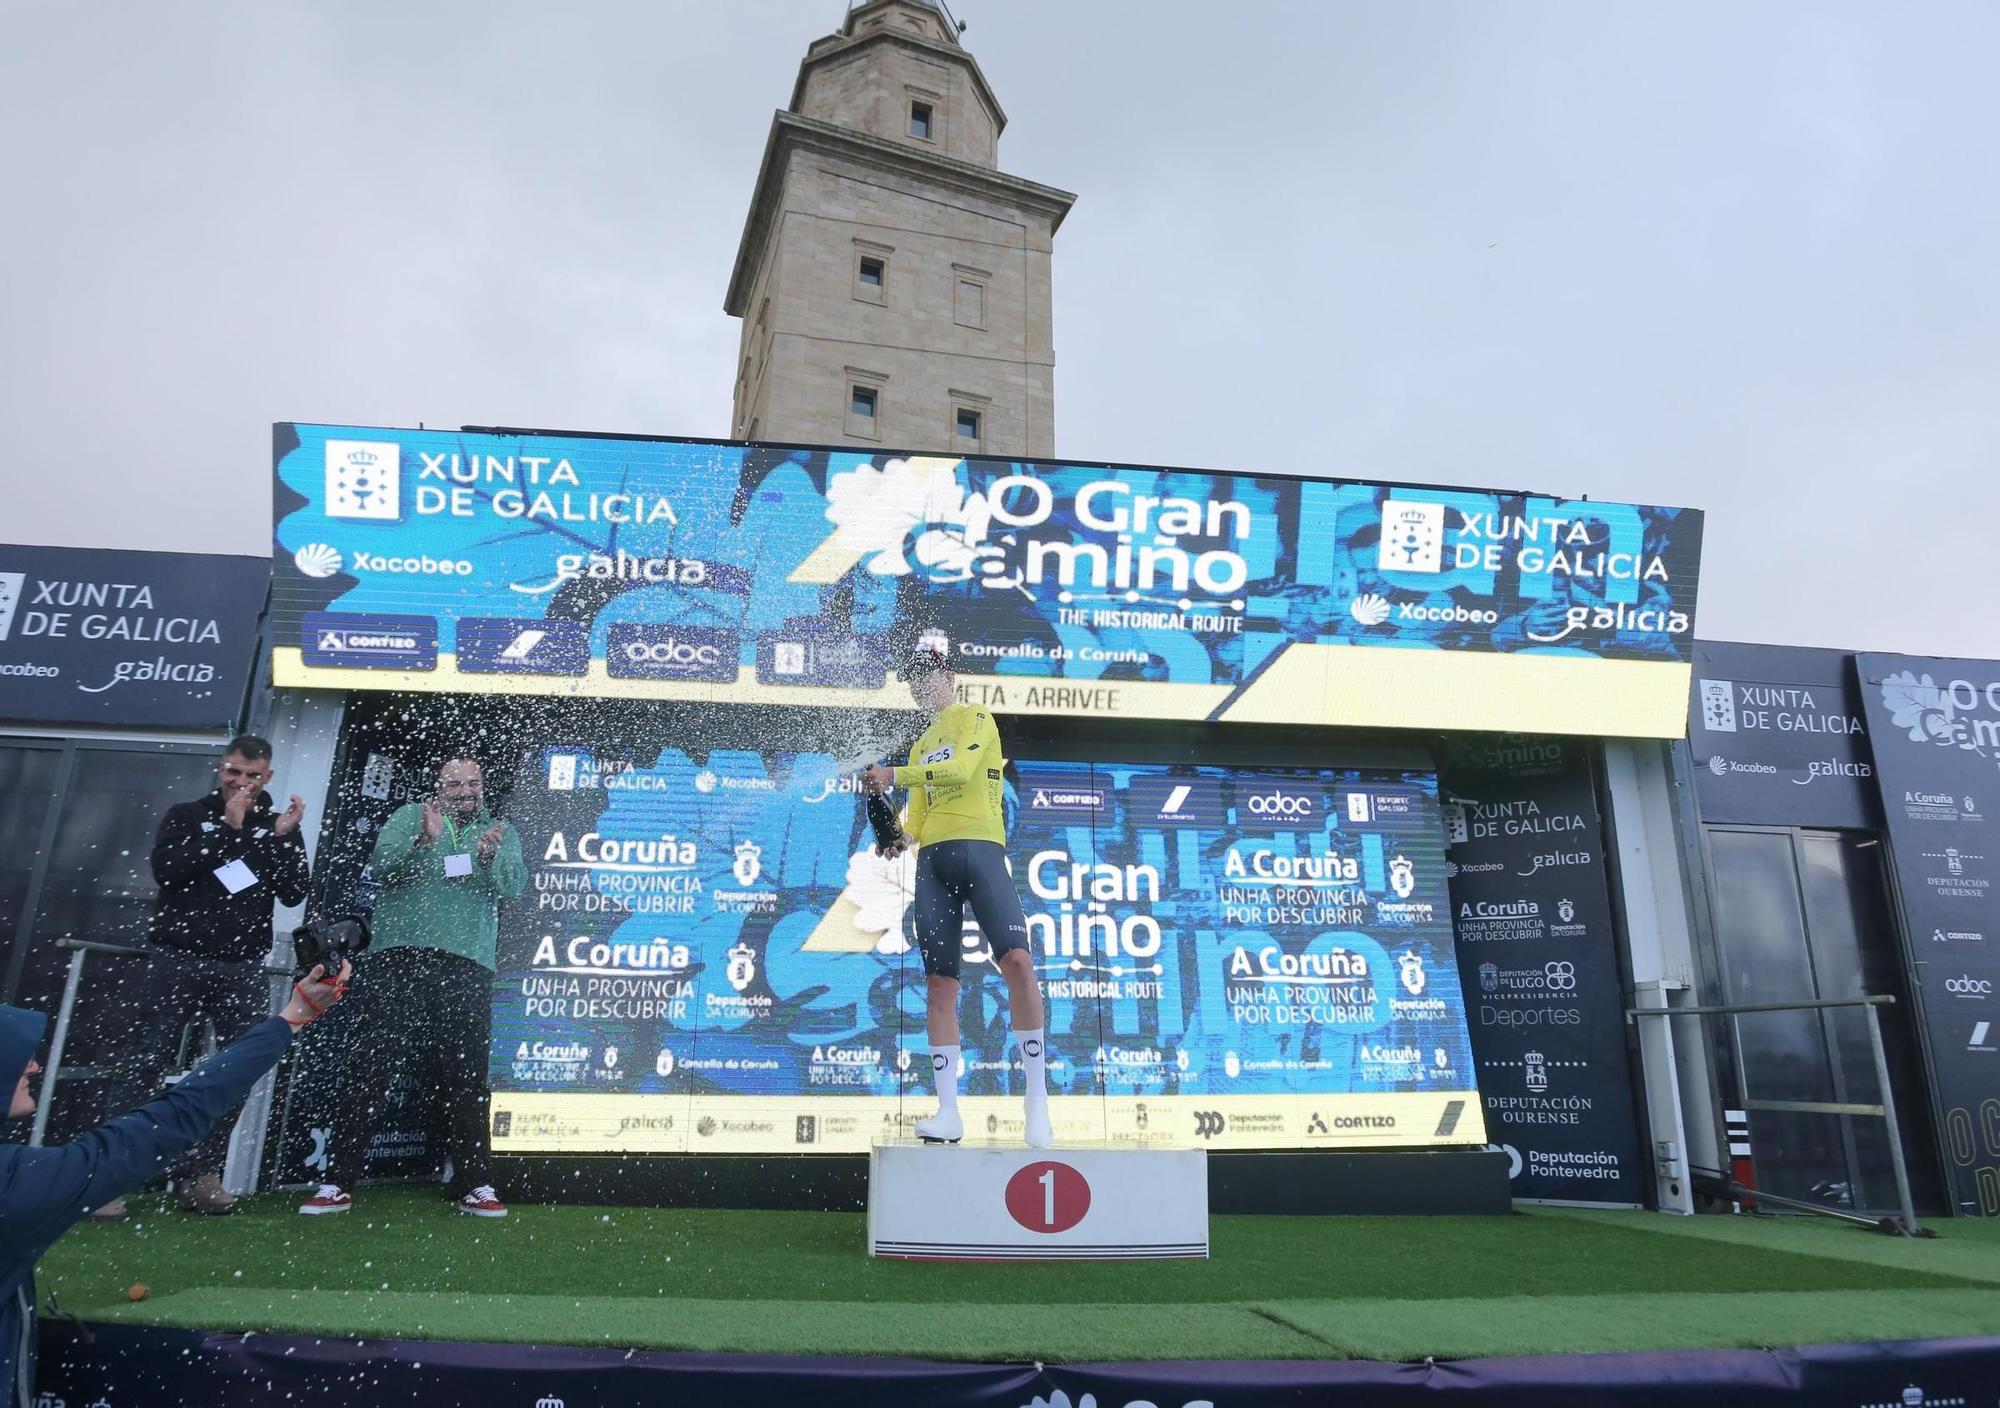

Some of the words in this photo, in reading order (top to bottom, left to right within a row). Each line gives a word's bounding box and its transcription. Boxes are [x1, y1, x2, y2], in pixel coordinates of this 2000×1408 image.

[418, 451, 582, 487] XUNTA
[416, 487, 475, 517] DE
[492, 489, 679, 526] GALICIA
[988, 475, 1053, 527] O
[1074, 480, 1251, 539] Gran
[1459, 511, 1592, 546] XUNTA
[353, 551, 473, 576] Xacobeo
[535, 549, 708, 590] galicia
[1455, 543, 1502, 571] DE
[1516, 549, 1669, 582] GALICIA
[31, 580, 154, 609] XUNTA
[1058, 608, 1095, 626] THE
[1094, 610, 1188, 630] HISTORICAL
[1192, 614, 1244, 634] ROUTE
[1399, 601, 1498, 625] Xacobeo
[1546, 603, 1689, 638] galicia
[21, 611, 72, 637] DE
[80, 614, 221, 644] GALICIA
[625, 638, 721, 664] adoc
[959, 642, 1044, 659] Concello
[1049, 643, 1073, 660] da
[1079, 644, 1150, 664] Coruña
[0, 662, 60, 678] cobeo
[96, 656, 214, 688] galicia
[1025, 687, 1120, 710] ARRIVEE
[1741, 687, 1816, 709] XUNTA
[1743, 711, 1770, 730] DE
[1777, 712, 1865, 735] GALICIA
[580, 760, 635, 773] XUNTA
[1730, 761, 1776, 774] Xacobeo
[1800, 758, 1872, 782] galicia
[578, 775, 599, 789] DE
[603, 775, 667, 790] GALICIA
[1248, 790, 1312, 816] adoc
[1905, 792, 1914, 801] A
[1915, 792, 1954, 803] Coruña
[1473, 800, 1540, 820] XUNTA
[1474, 823, 1498, 838] DE
[1505, 815, 1586, 835] GALICIA
[544, 831, 567, 861] A
[578, 832, 697, 864] Coruña
[1224, 849, 1247, 877] A
[1253, 850, 1358, 879] Coruña
[1461, 863, 1504, 872] Xacobeo
[1525, 851, 1591, 873] galicia
[534, 872, 591, 891] UNHA
[597, 874, 702, 893] PROVINCIA
[1028, 850, 1159, 902] Gran
[1927, 877, 1990, 887] DEPUTACIÓN
[1220, 889, 1271, 906] UNHA
[1276, 888, 1368, 906] PROVINCIA
[1938, 888, 1984, 897] OURENSE
[539, 894, 578, 912] POR
[585, 894, 694, 913] DESCUBRIR
[1460, 902, 1473, 917] A
[1476, 900, 1539, 916] Coruña
[1227, 907, 1263, 924] POR
[1268, 907, 1363, 925] DESCUBRIR
[1458, 922, 1487, 932] UNHA
[1489, 919, 1545, 931] PROVINCIA
[1462, 932, 1483, 942] POR
[1485, 929, 1543, 941] DESCUBRIR
[1551, 923, 1586, 932] Deputación
[1947, 932, 1982, 940] CORTIZO
[532, 936, 557, 966] A
[567, 937, 690, 969] Coruña
[1231, 946, 1253, 975] A
[1259, 947, 1368, 976] Coruña
[1499, 969, 1543, 977] DEPUTACIÓN
[1510, 977, 1544, 989] LUGO
[521, 977, 580, 996] UNHA
[587, 978, 695, 998] PROVINCIA
[1048, 982, 1122, 999] HISTORICAL
[1126, 982, 1164, 999] ROUTE
[1946, 974, 1992, 993] adoc
[1226, 987, 1280, 1004] UNHA
[1284, 986, 1380, 1004] PROVINCIA
[1482, 992, 1578, 1000] VICEPRESIDENCIA
[525, 999, 565, 1017] POR
[573, 1000, 687, 1019] DESCUBRIR
[1234, 1006, 1272, 1023] POR
[1276, 1005, 1376, 1024] DESCUBRIR
[1480, 1005, 1581, 1028] Deportes
[517, 1041, 528, 1057] A
[533, 1041, 588, 1057] Coruña
[812, 1046, 824, 1061] A
[827, 1046, 881, 1062] Coruña
[1095, 1047, 1107, 1062] A
[1111, 1047, 1162, 1062] Coruña
[1361, 1046, 1370, 1060] A
[1373, 1045, 1421, 1060] Coruña
[1487, 1096, 1592, 1110] DEPUTACIÓN
[1334, 1116, 1395, 1128] CORTIZO
[1503, 1112, 1580, 1125] OURENSE
[1529, 1150, 1618, 1166] Deputación
[1530, 1164, 1620, 1180] Pontevedra
[1039, 1170, 1054, 1224] 1
